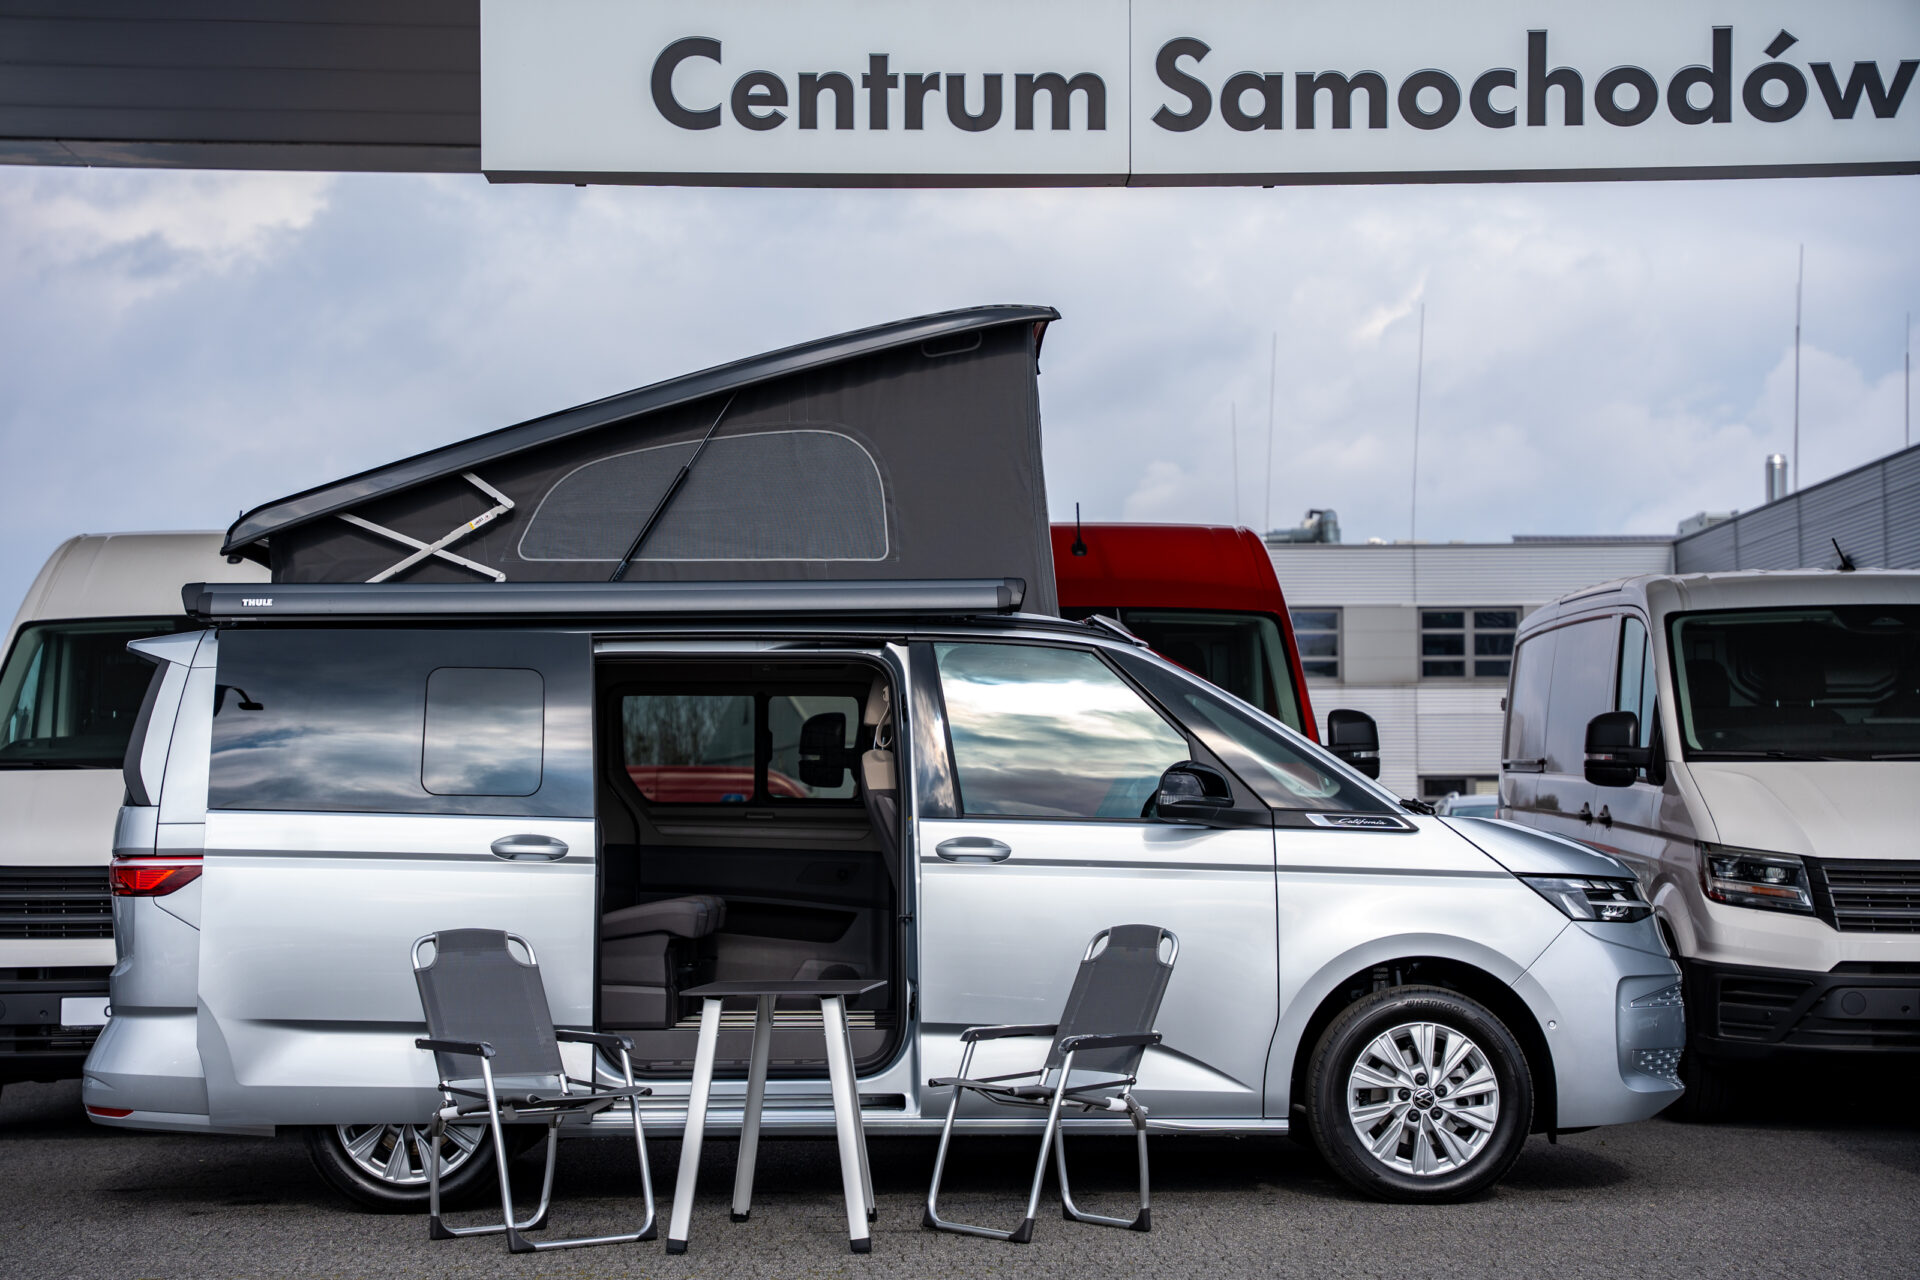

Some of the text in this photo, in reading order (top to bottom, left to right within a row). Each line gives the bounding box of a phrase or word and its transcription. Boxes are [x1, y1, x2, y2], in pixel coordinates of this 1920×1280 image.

[650, 25, 1920, 133] Centrum Samochodów
[241, 598, 273, 607] THULE
[1337, 817, 1387, 826] California
